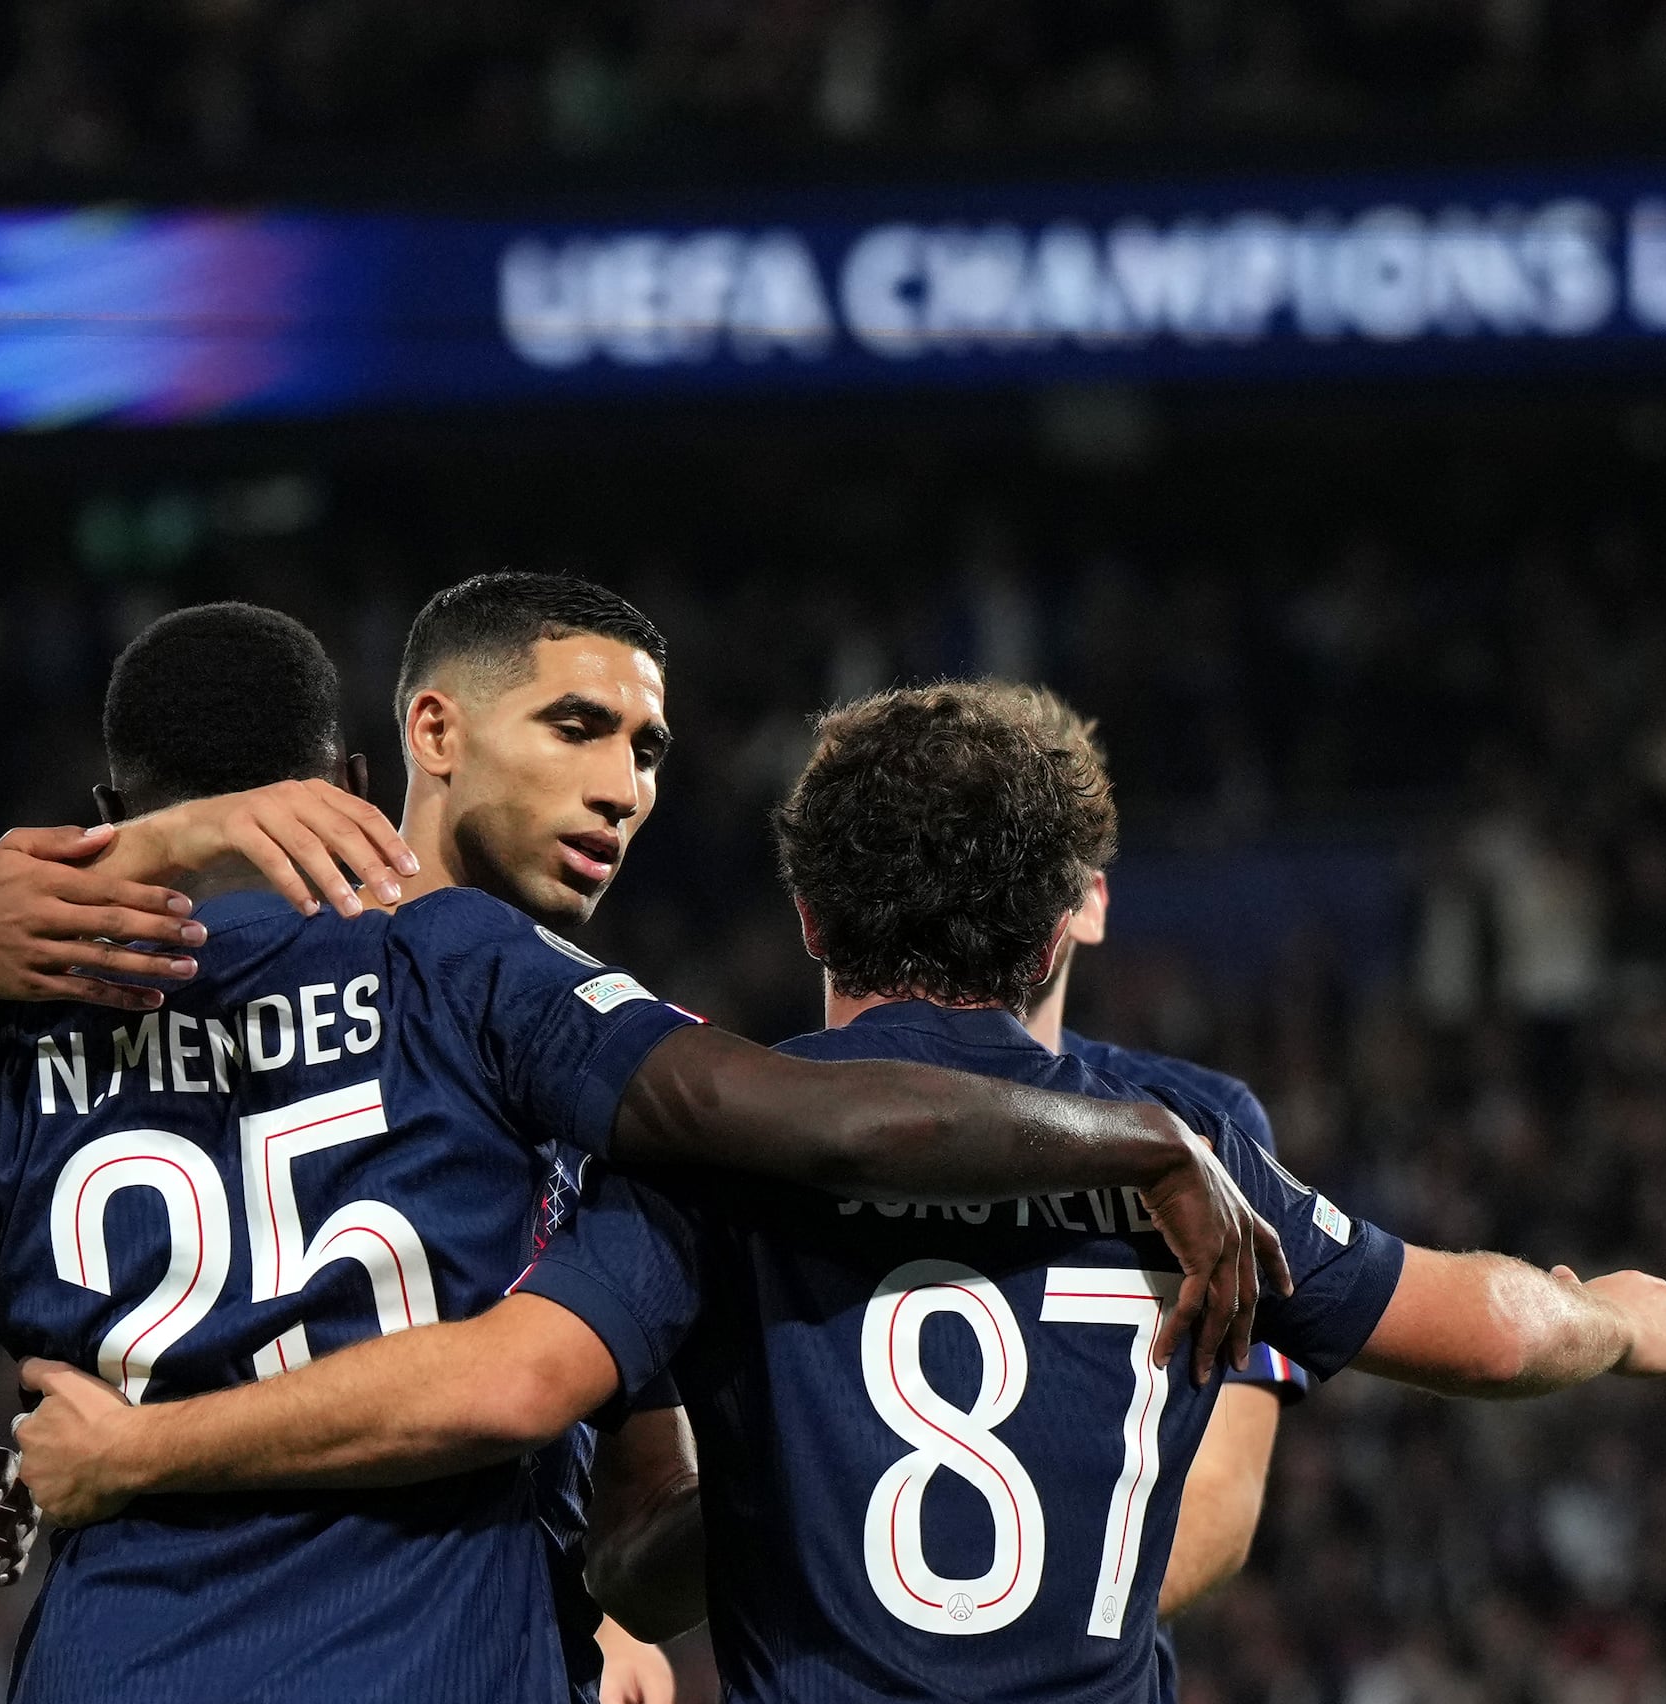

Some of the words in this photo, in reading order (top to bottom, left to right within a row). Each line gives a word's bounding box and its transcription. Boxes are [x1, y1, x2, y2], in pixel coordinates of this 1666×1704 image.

[499, 230, 825, 365] UEFA
[839, 200, 1613, 352] CHAMPIONS
[37, 973, 382, 1115] N.MENDES
[579, 981, 601, 994] UEFA
[50, 1079, 439, 1405] 25
[861, 1259, 1188, 1640] 87
